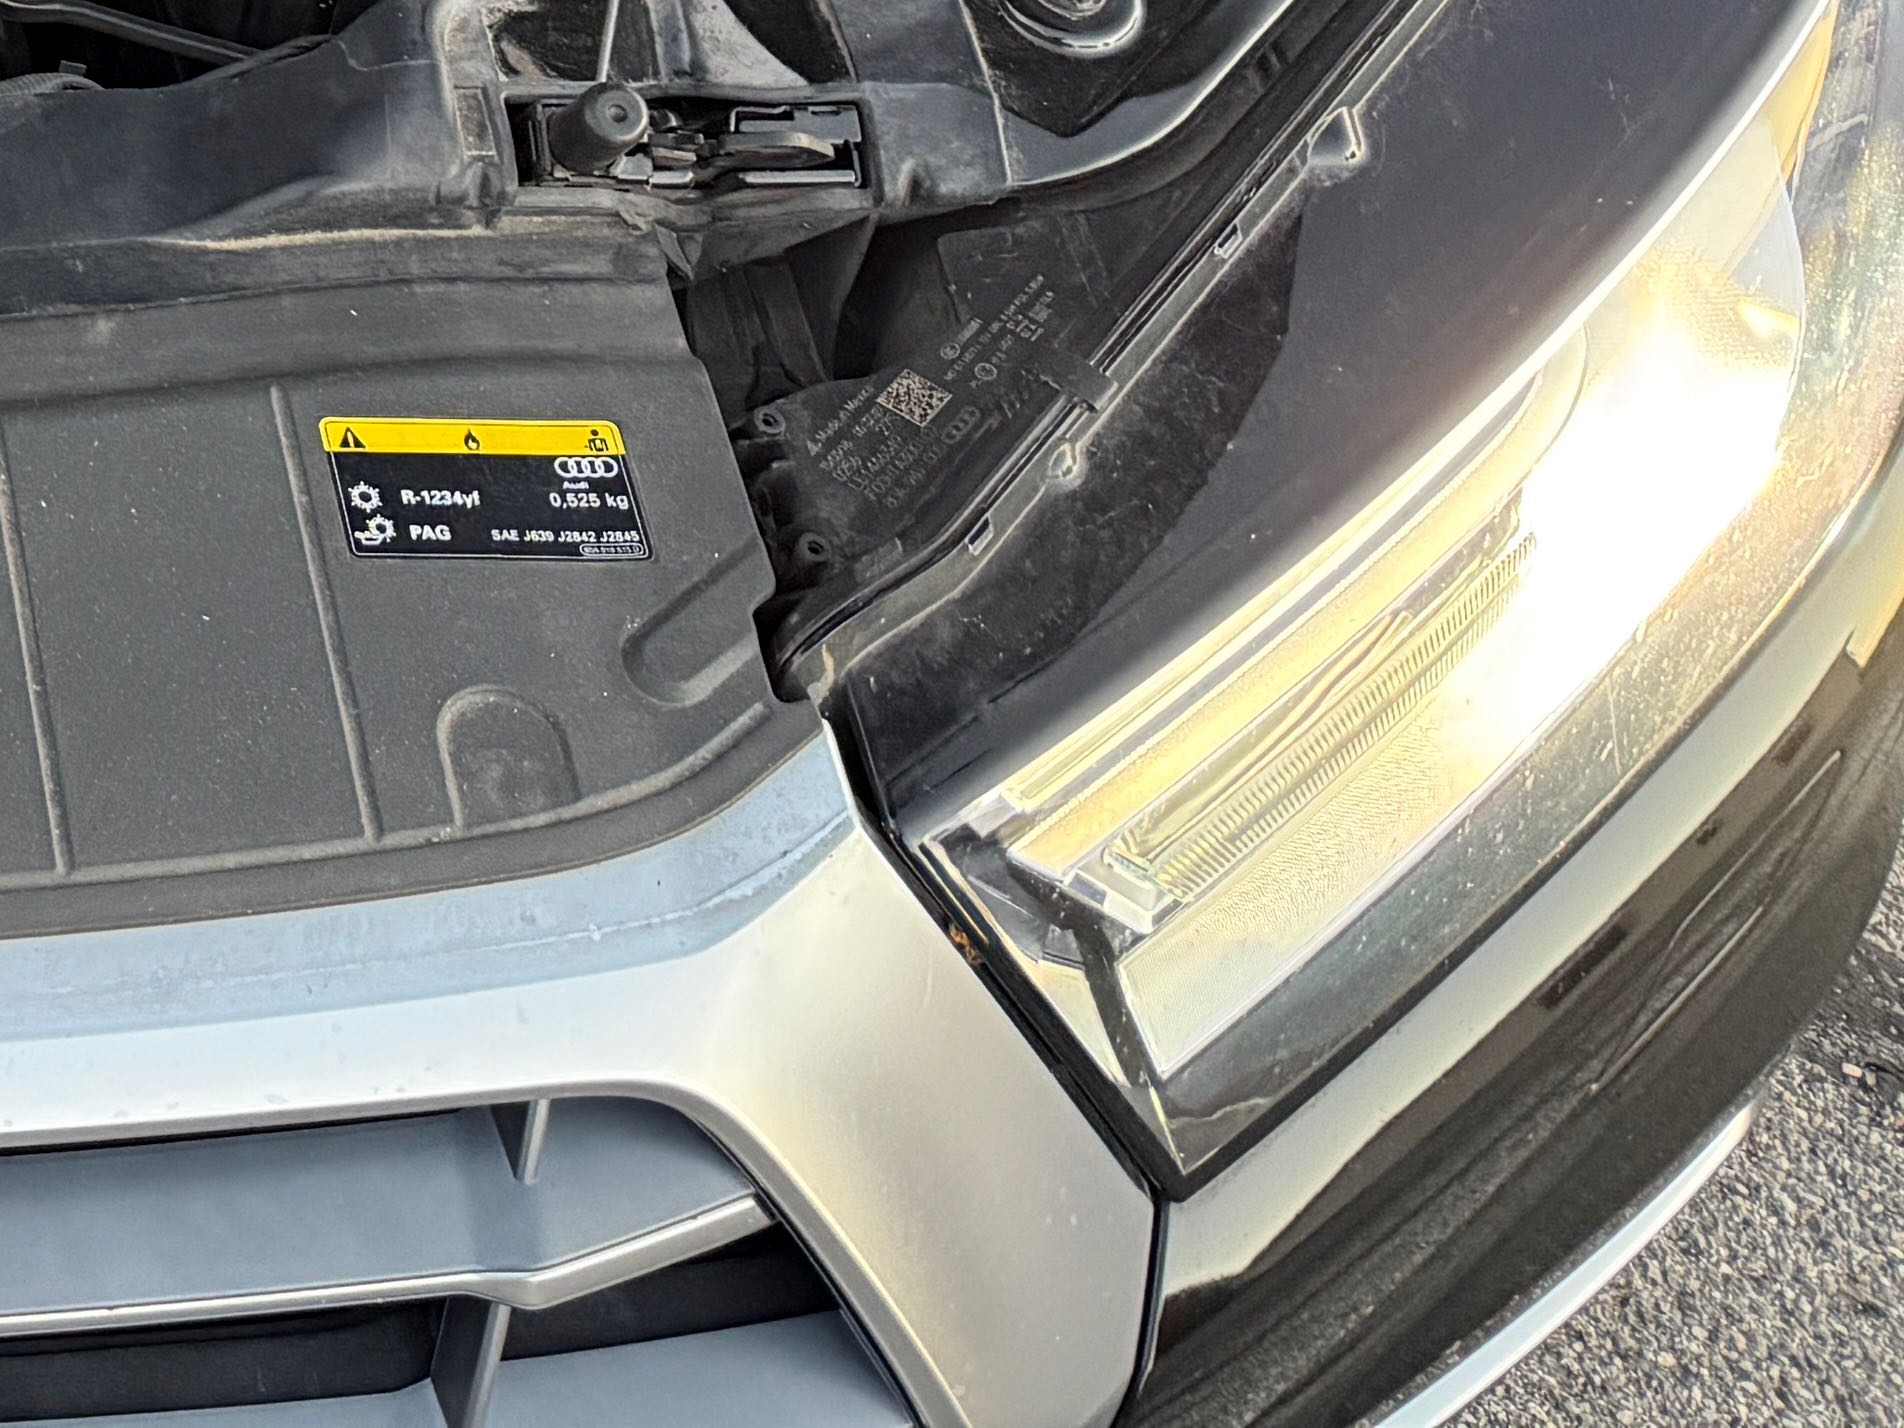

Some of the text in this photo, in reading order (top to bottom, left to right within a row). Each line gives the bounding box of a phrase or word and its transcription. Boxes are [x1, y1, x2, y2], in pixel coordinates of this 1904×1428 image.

[563, 481, 589, 489] Audi
[401, 489, 481, 509] R-1234yf
[549, 493, 629, 509] 0,525 kg
[410, 525, 452, 540] PAG
[491, 529, 640, 543] SAE J639 J2842 J2845
